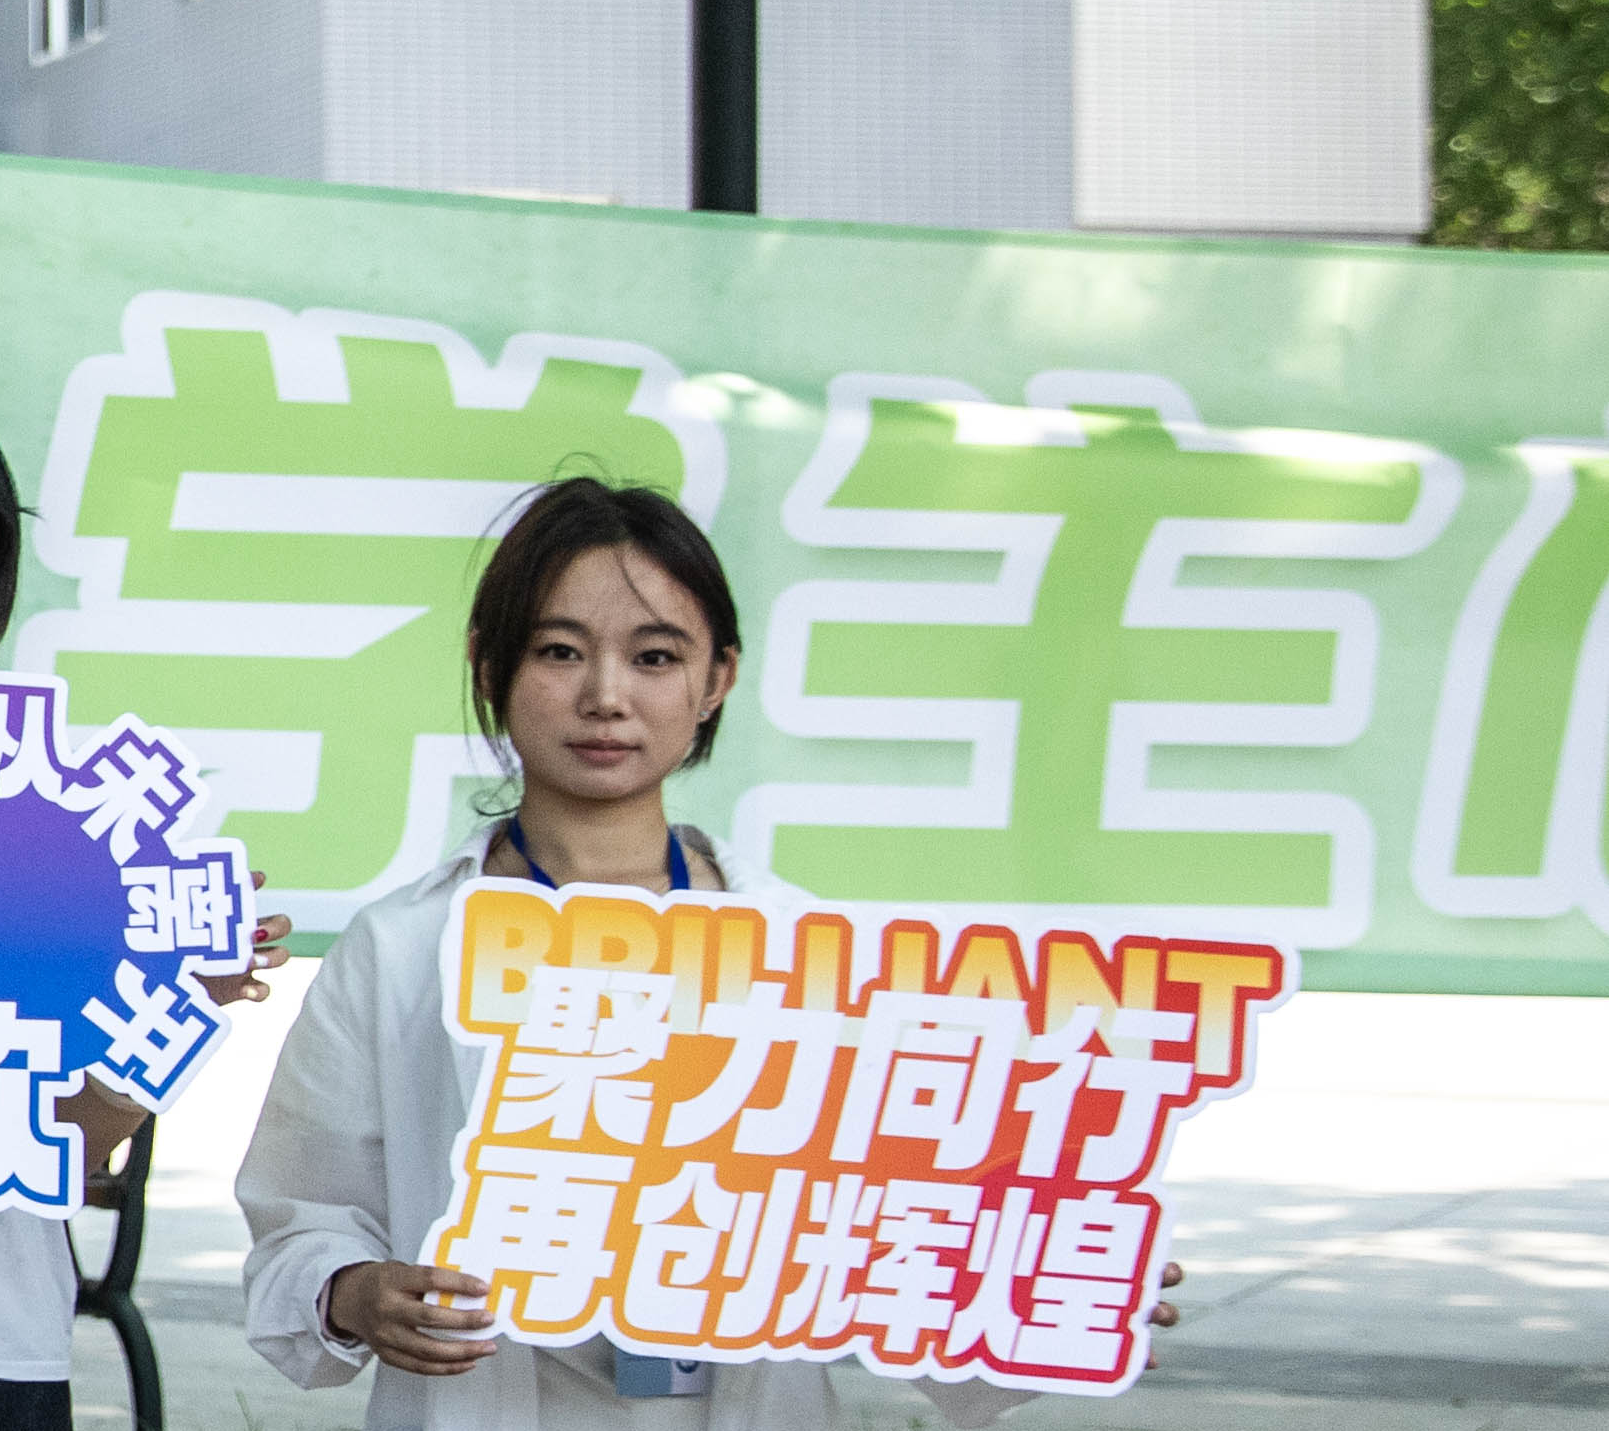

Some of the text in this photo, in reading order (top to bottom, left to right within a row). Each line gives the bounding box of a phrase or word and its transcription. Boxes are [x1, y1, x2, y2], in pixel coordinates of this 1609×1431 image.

[493, 964, 1196, 1184] 聚力同行
[450, 1146, 1150, 1373] 再创辉煌
